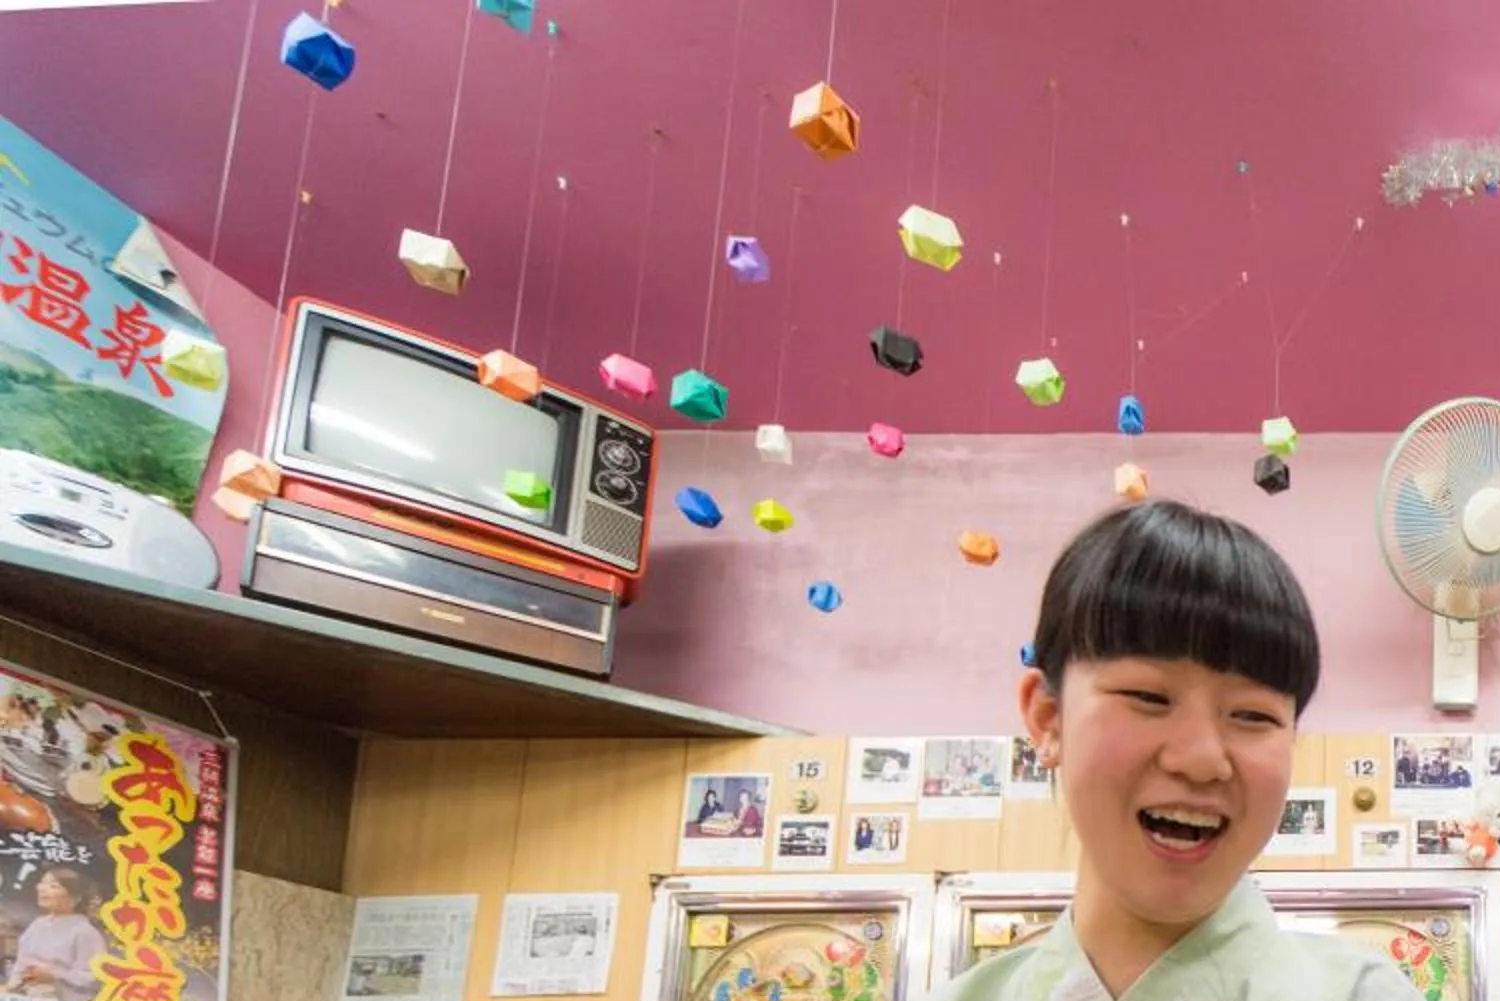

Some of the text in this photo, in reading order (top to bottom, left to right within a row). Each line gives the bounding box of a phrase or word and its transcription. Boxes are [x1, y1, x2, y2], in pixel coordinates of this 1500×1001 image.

[0, 235, 174, 398] 温泉
[796, 761, 820, 779] 15
[1352, 760, 1375, 776] 12
